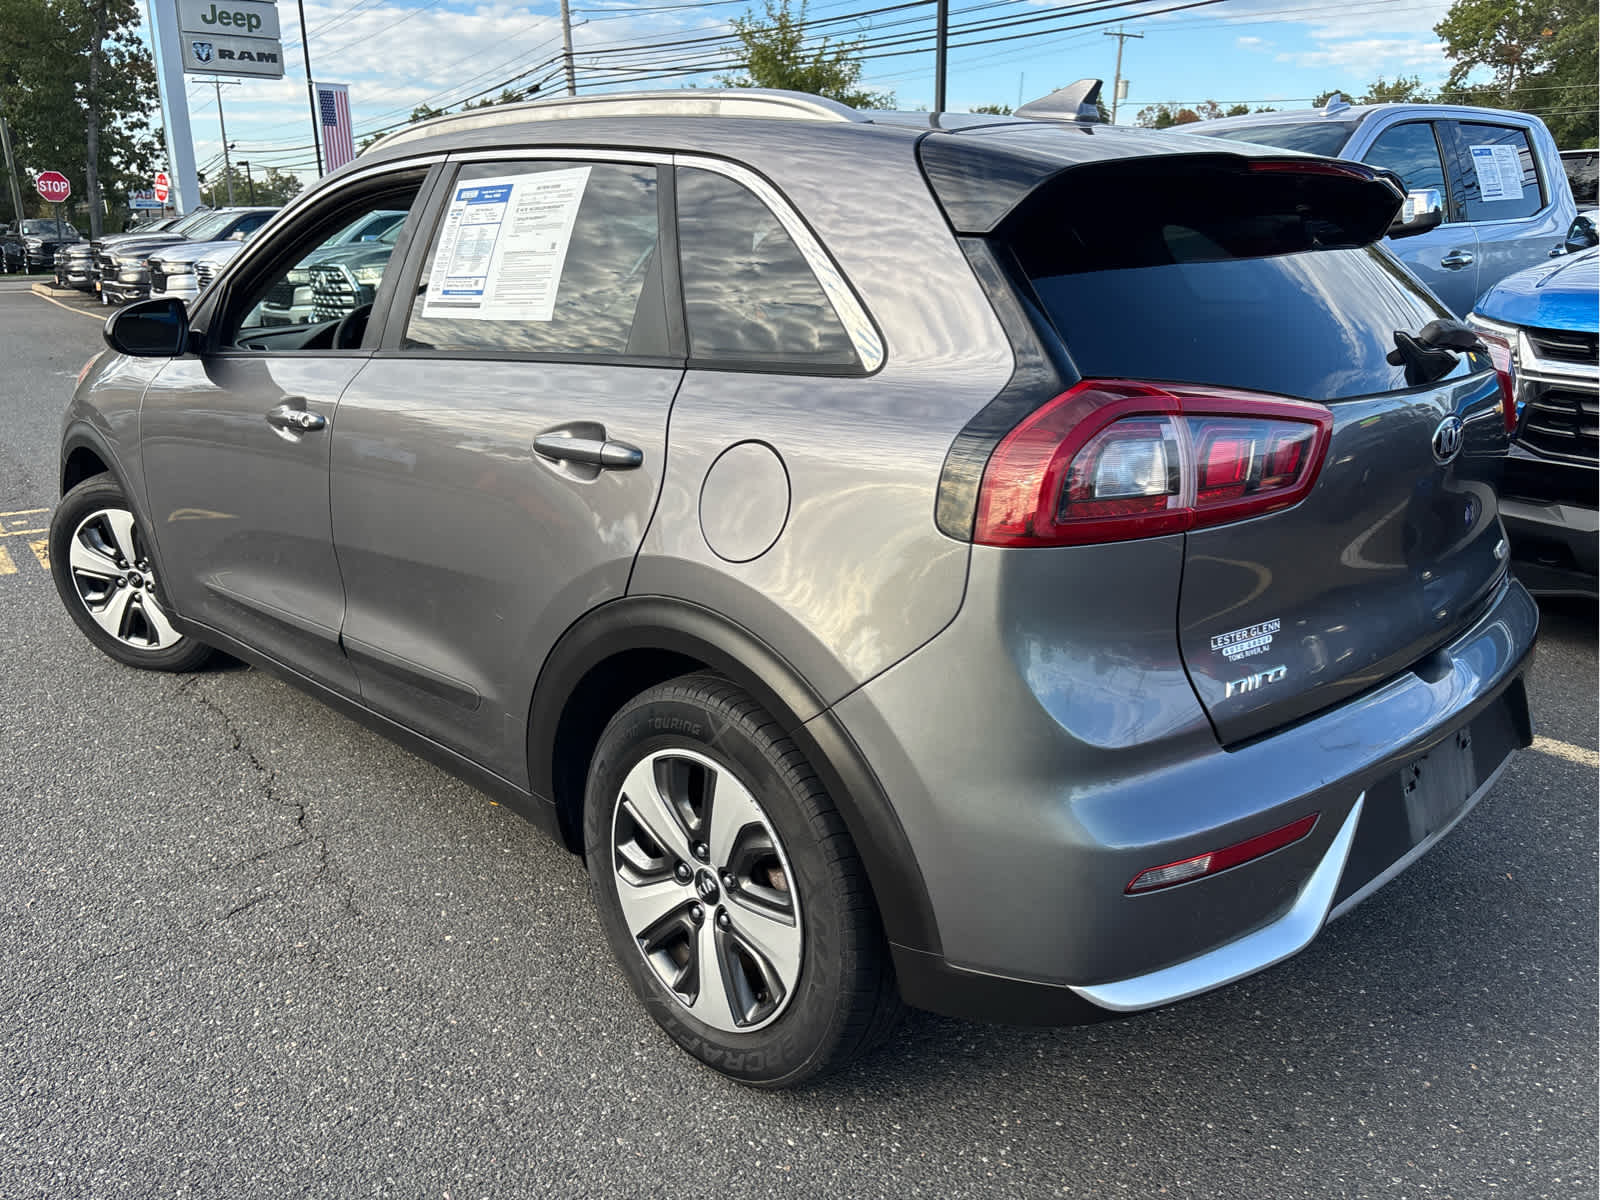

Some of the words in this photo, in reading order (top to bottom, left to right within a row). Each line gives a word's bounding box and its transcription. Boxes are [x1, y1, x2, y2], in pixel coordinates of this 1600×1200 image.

[201, 4, 261, 32] Jeep
[218, 49, 278, 63] RAM
[39, 180, 68, 192] STOP
[1211, 630, 1248, 648] LESTER
[1250, 620, 1280, 637] GLENN
[648, 717, 704, 736] TOURING
